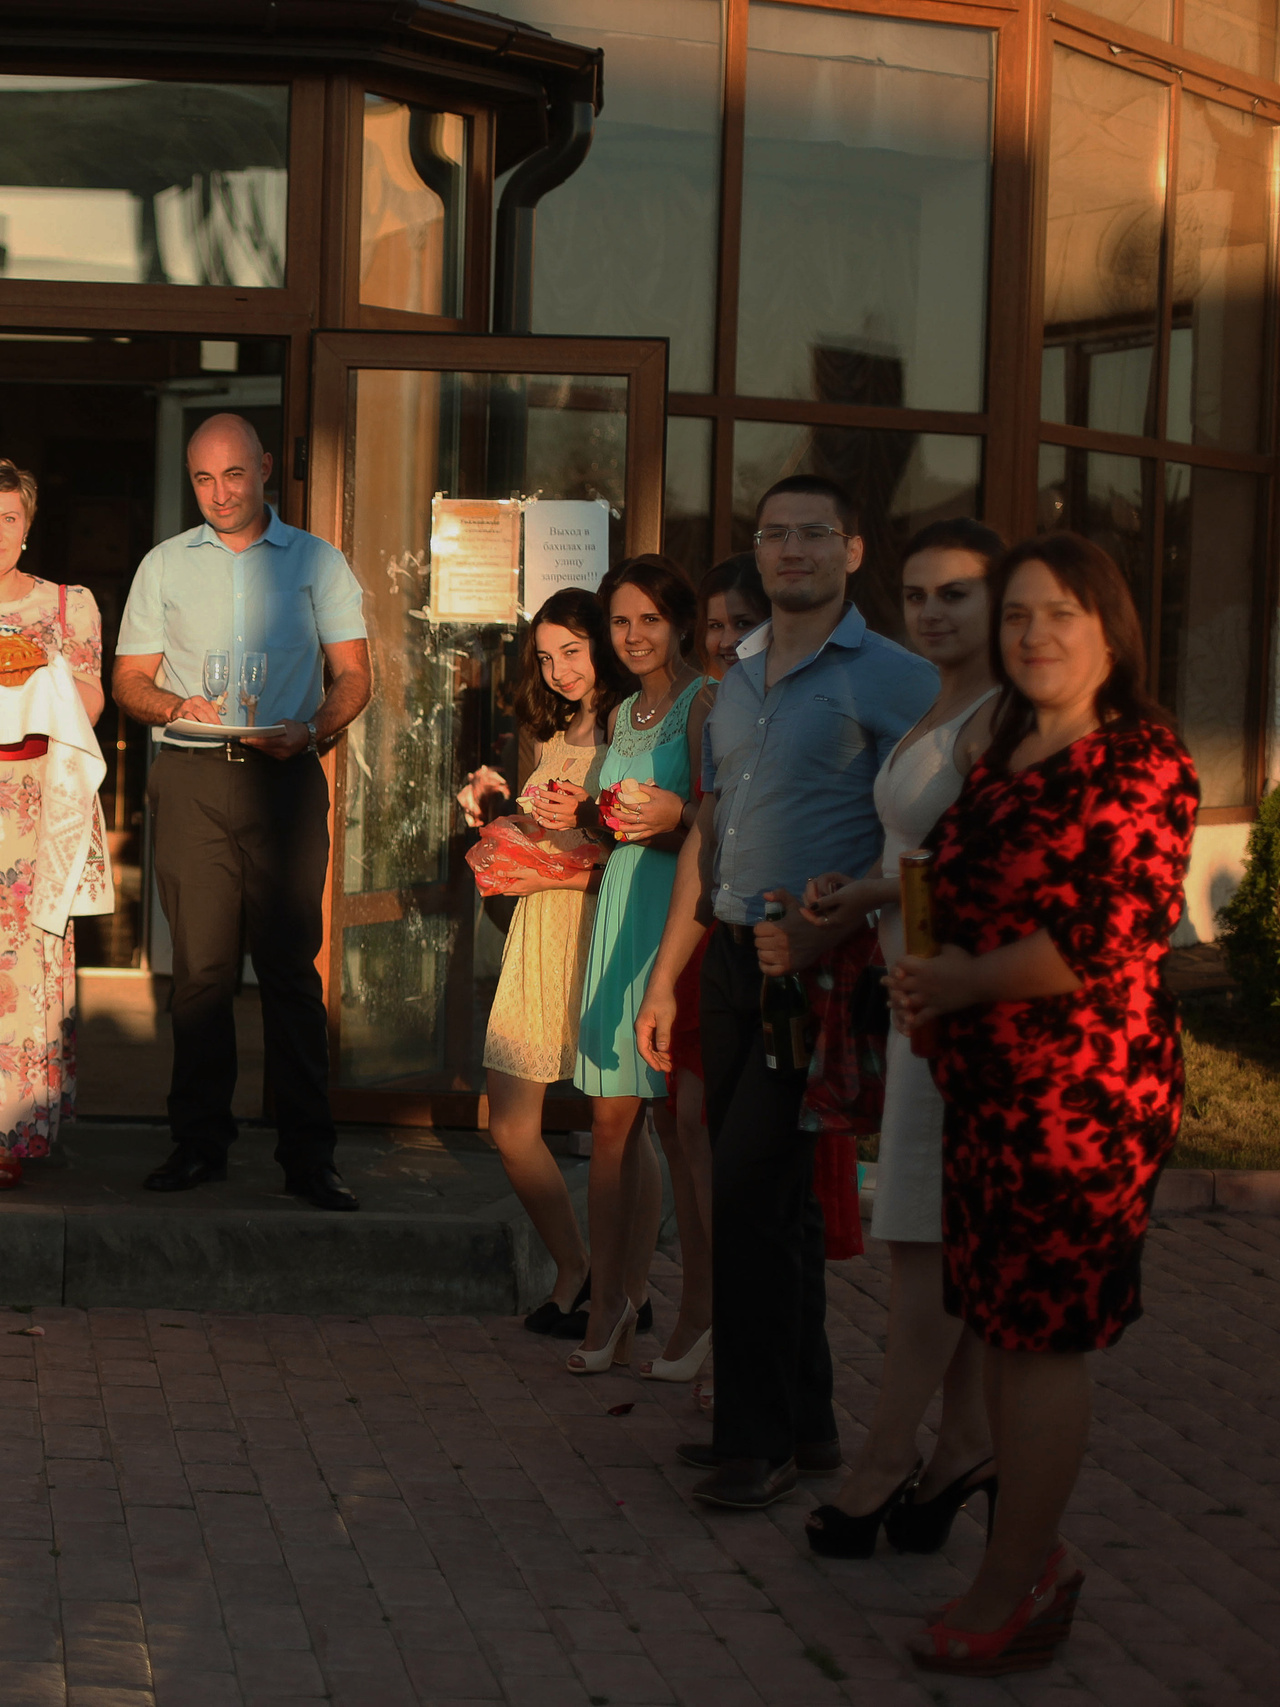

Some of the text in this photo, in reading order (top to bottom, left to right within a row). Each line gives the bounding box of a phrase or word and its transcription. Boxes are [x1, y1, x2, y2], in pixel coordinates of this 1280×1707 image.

[549, 526, 590, 537] Выход в
[543, 541, 596, 551] бахилах на
[554, 559, 584, 568] улицу
[541, 571, 598, 583] запрещен!!!
